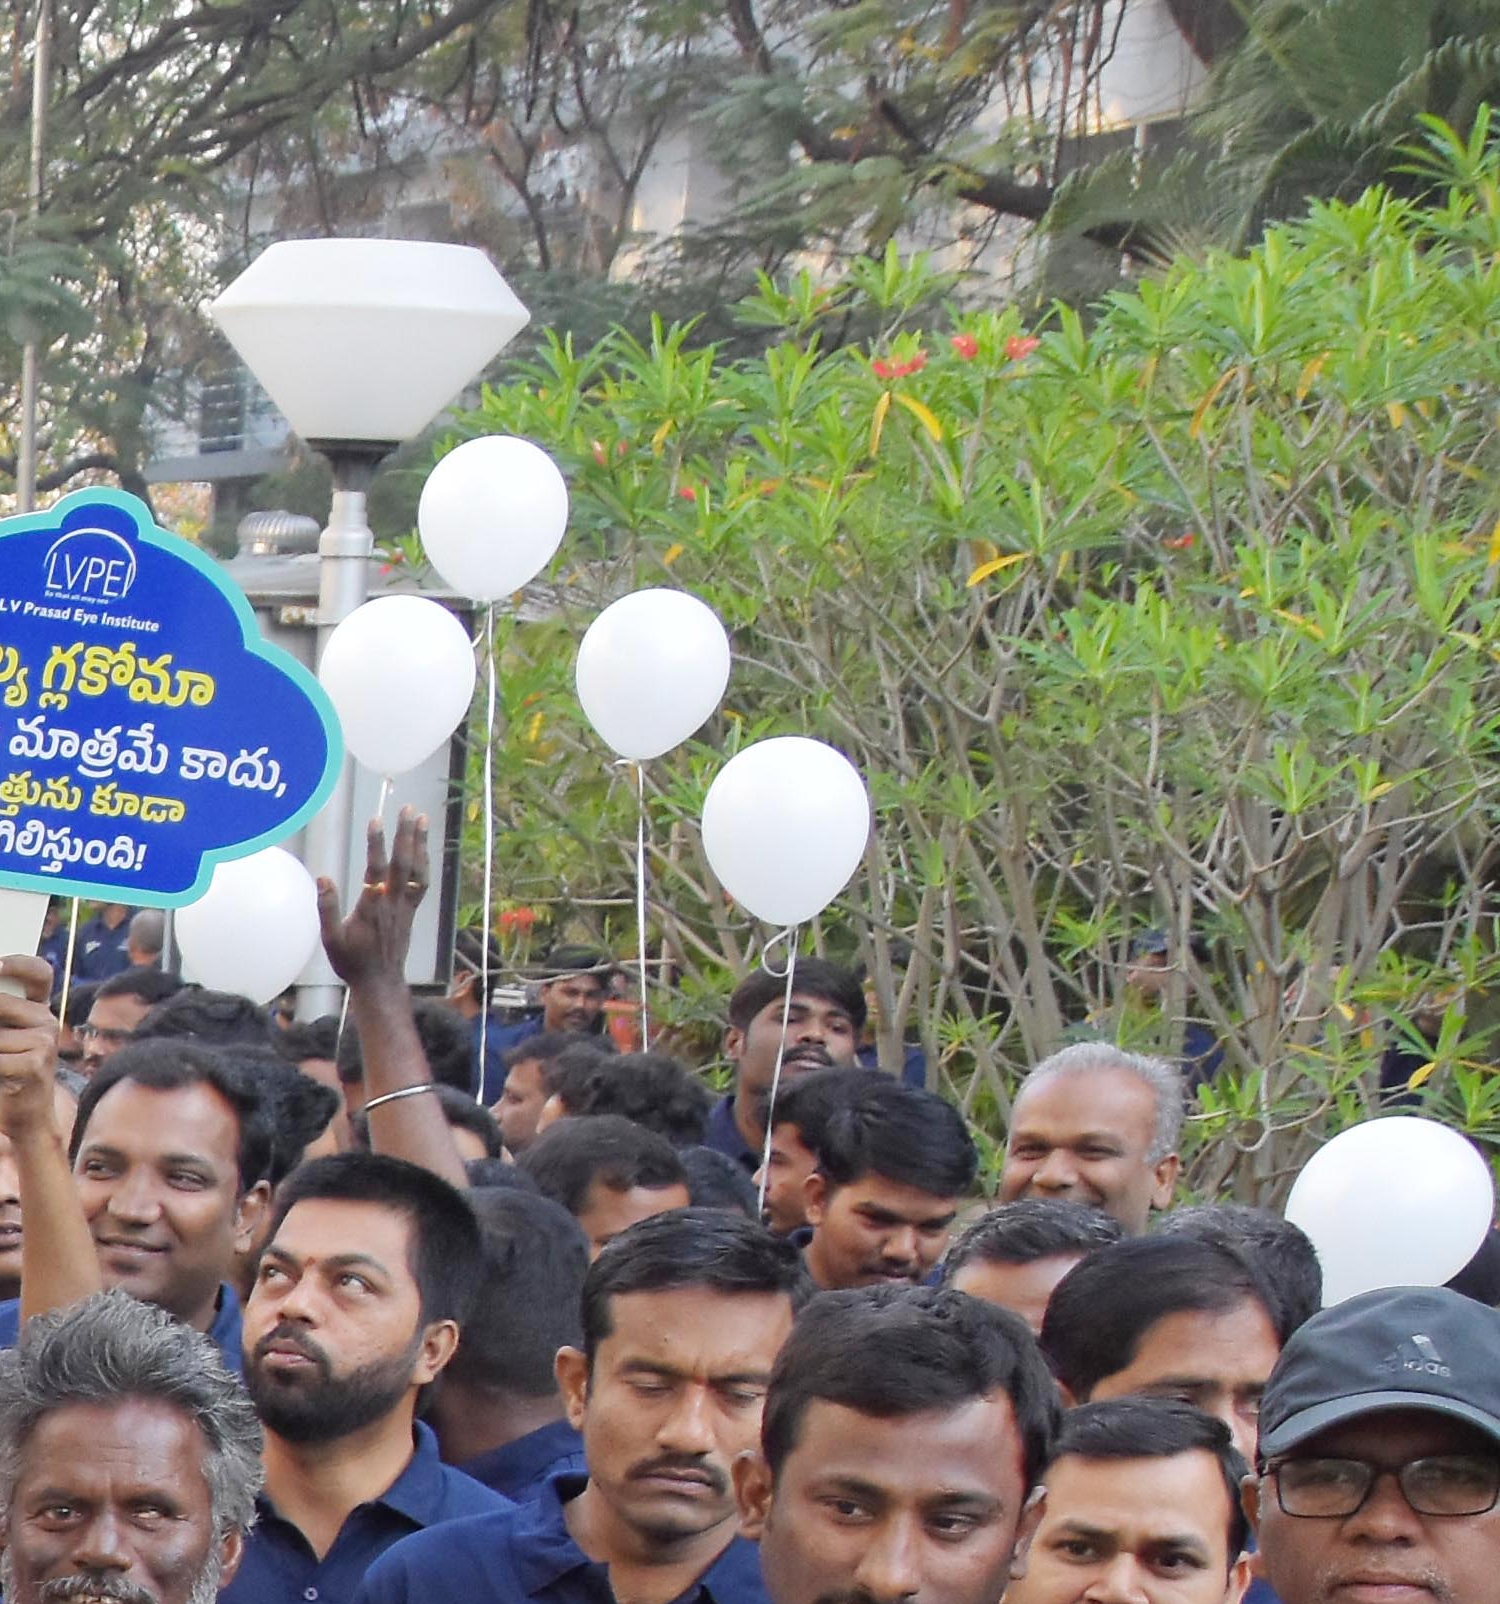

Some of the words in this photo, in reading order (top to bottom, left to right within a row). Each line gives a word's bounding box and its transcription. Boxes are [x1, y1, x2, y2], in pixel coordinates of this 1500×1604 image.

[46, 552, 134, 598] LVPEI
[10, 600, 21, 613] V
[23, 601, 71, 620] Prasad
[73, 609, 98, 626] Eye
[101, 613, 160, 632] Institute
[38, 640, 216, 711] గ్లకోమా
[8, 714, 169, 778] మాత్రమే
[179, 744, 288, 798] కాదు,
[89, 783, 186, 823] కూడా
